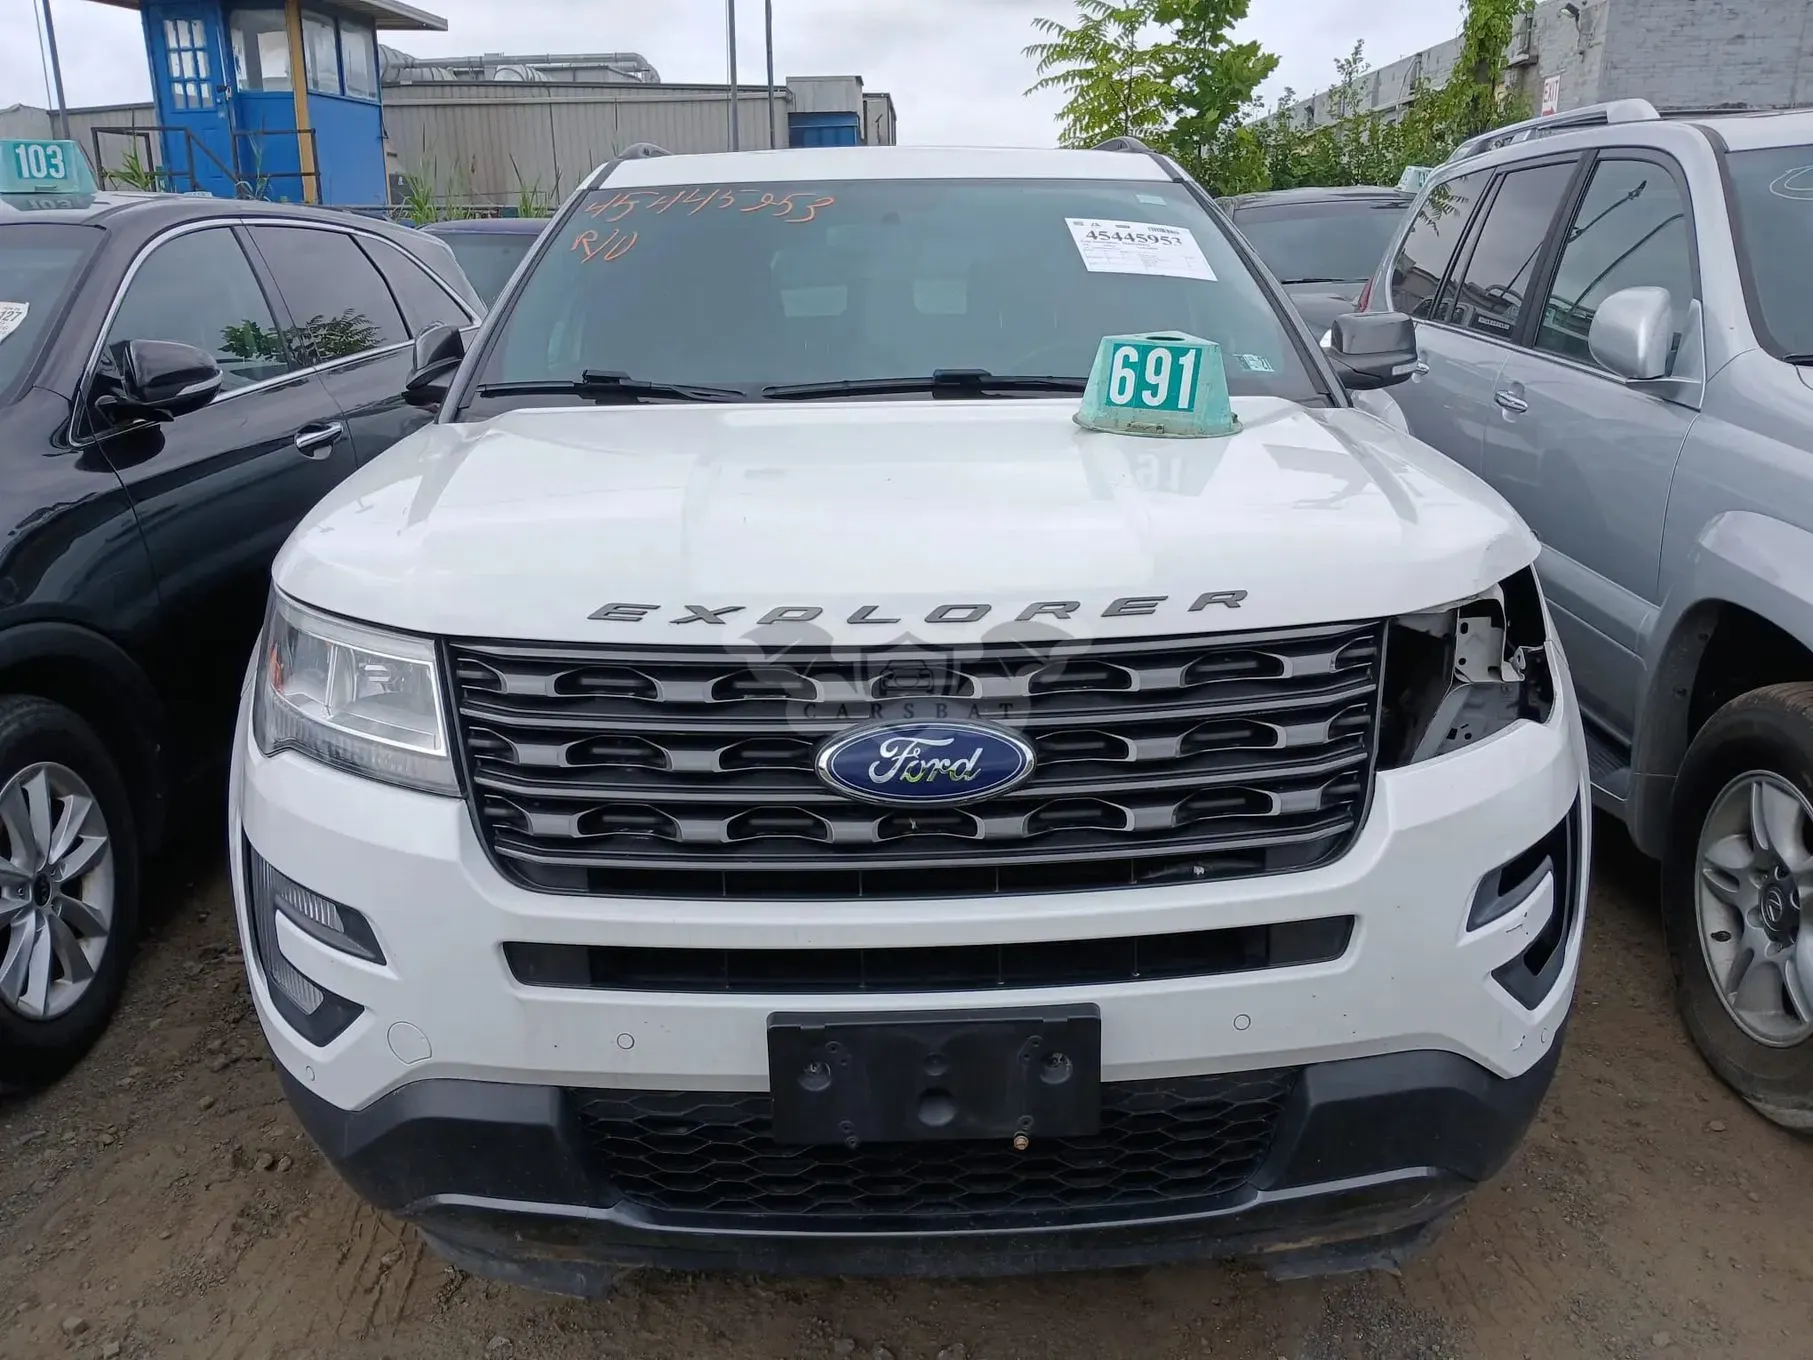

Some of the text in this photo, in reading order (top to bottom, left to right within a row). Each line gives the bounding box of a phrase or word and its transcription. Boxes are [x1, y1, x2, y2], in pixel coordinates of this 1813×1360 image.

[1543, 79, 1559, 103] EXIT
[15, 144, 66, 179] 103
[1086, 230, 1183, 247] 45445953
[1109, 346, 1197, 409] 691
[586, 589, 1249, 625] EXPLORER
[868, 737, 984, 784] Ford
